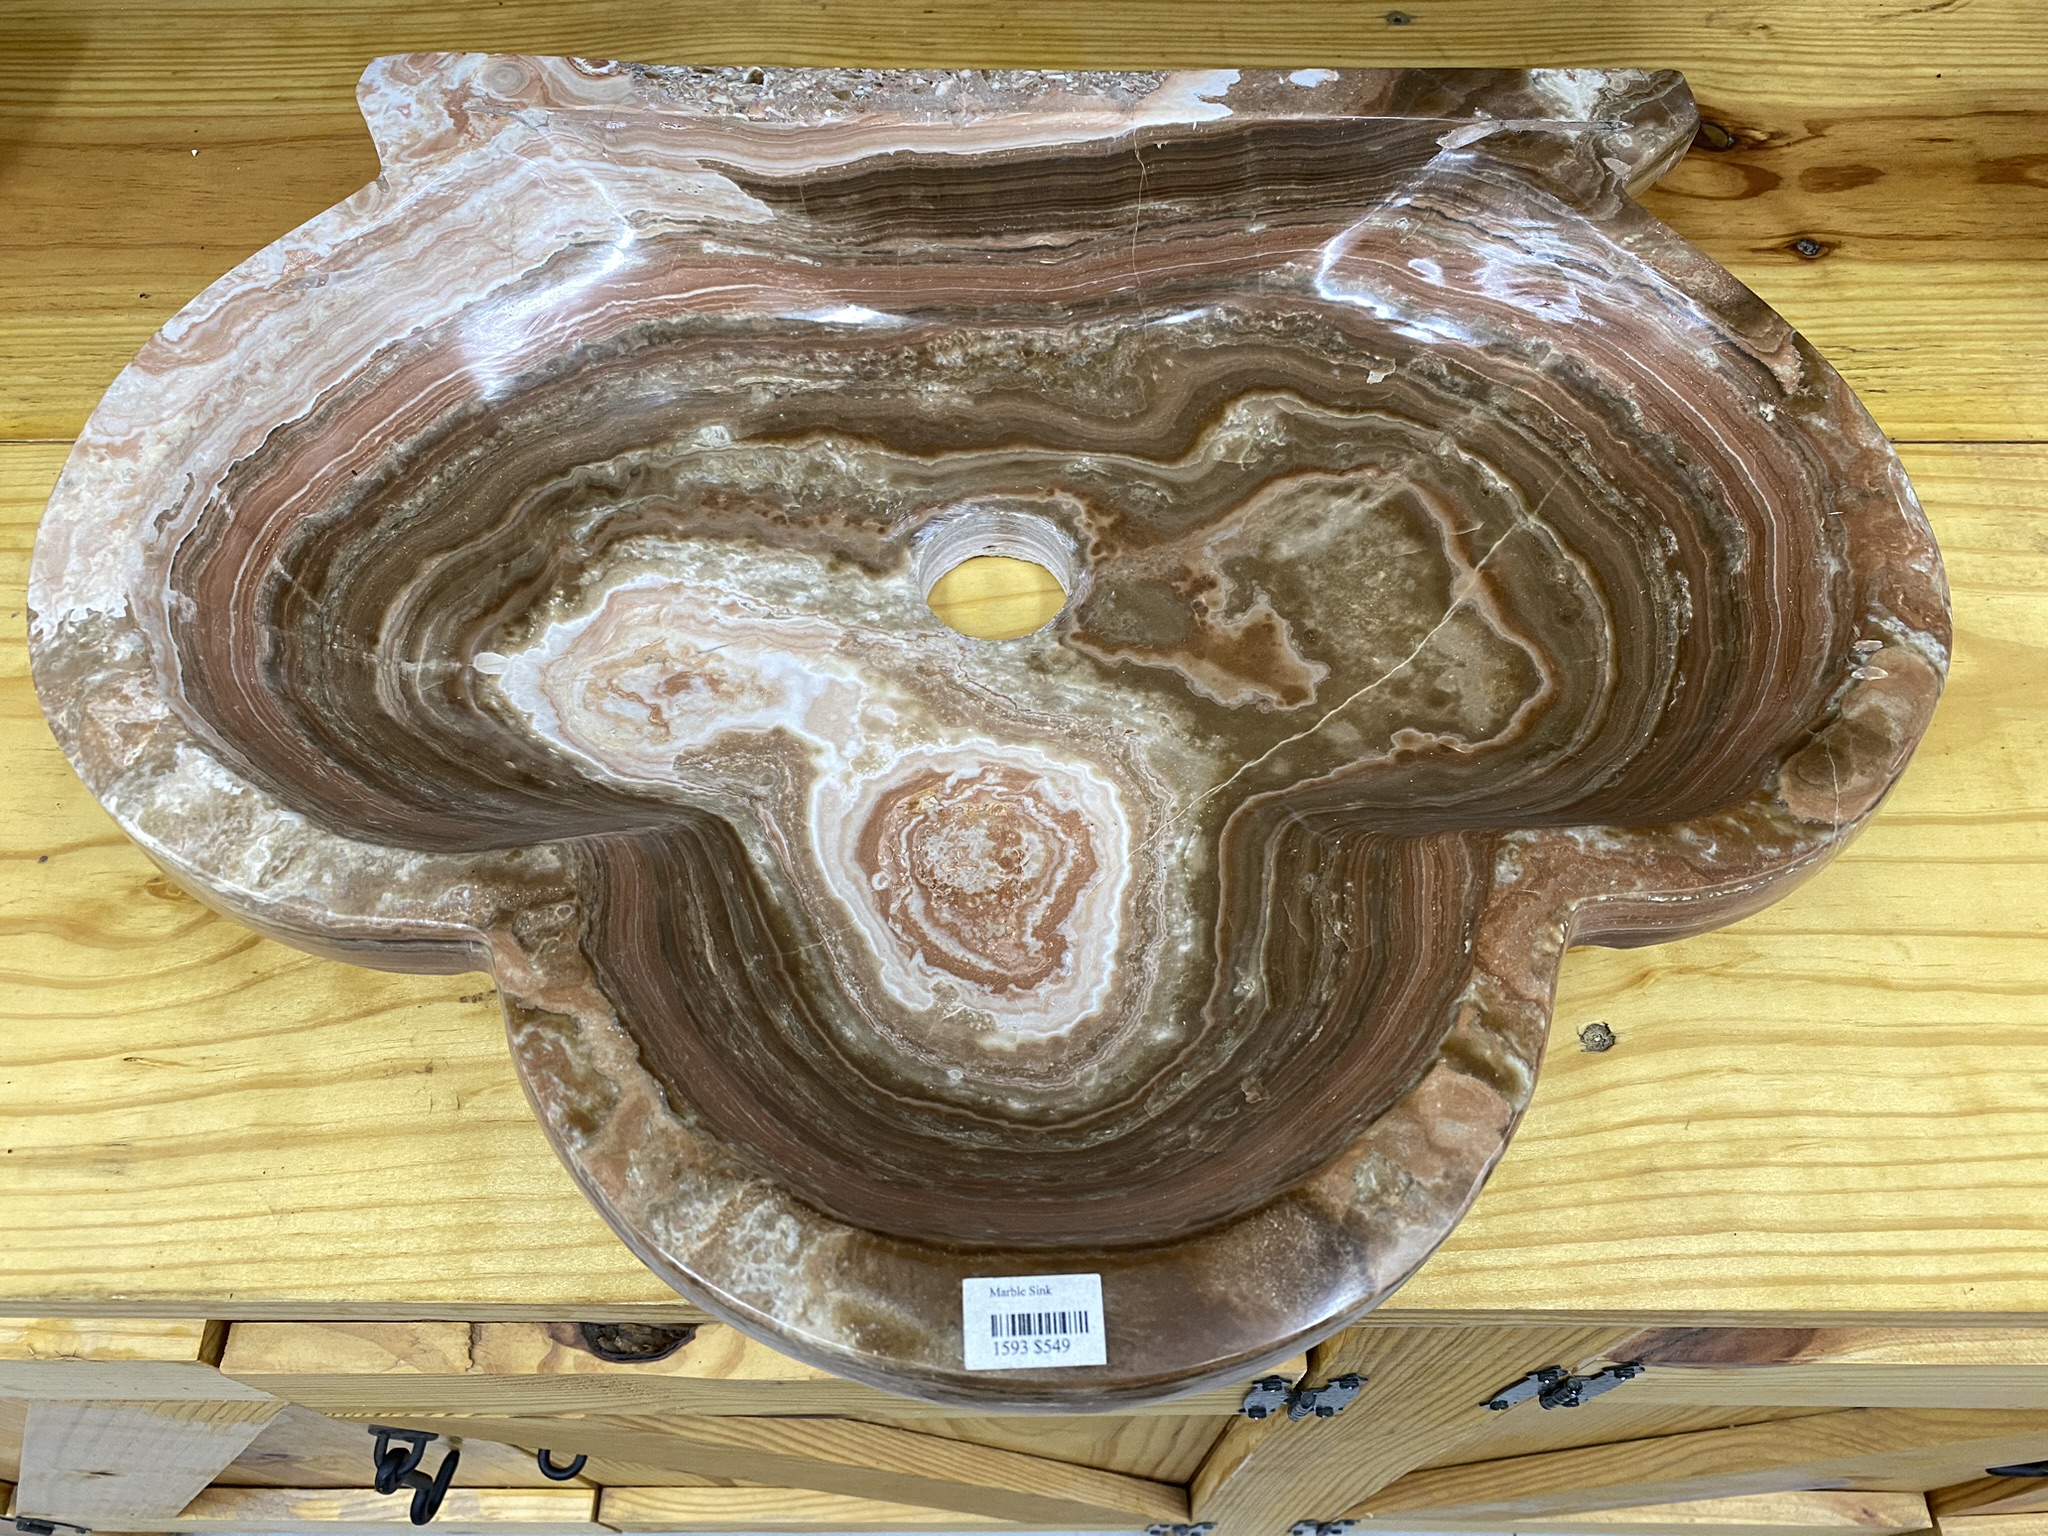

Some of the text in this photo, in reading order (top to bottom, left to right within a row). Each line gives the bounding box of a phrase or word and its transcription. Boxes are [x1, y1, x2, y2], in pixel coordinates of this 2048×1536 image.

[989, 1285, 1052, 1297] Marble Sink
[994, 1341, 1028, 1356] 1593
